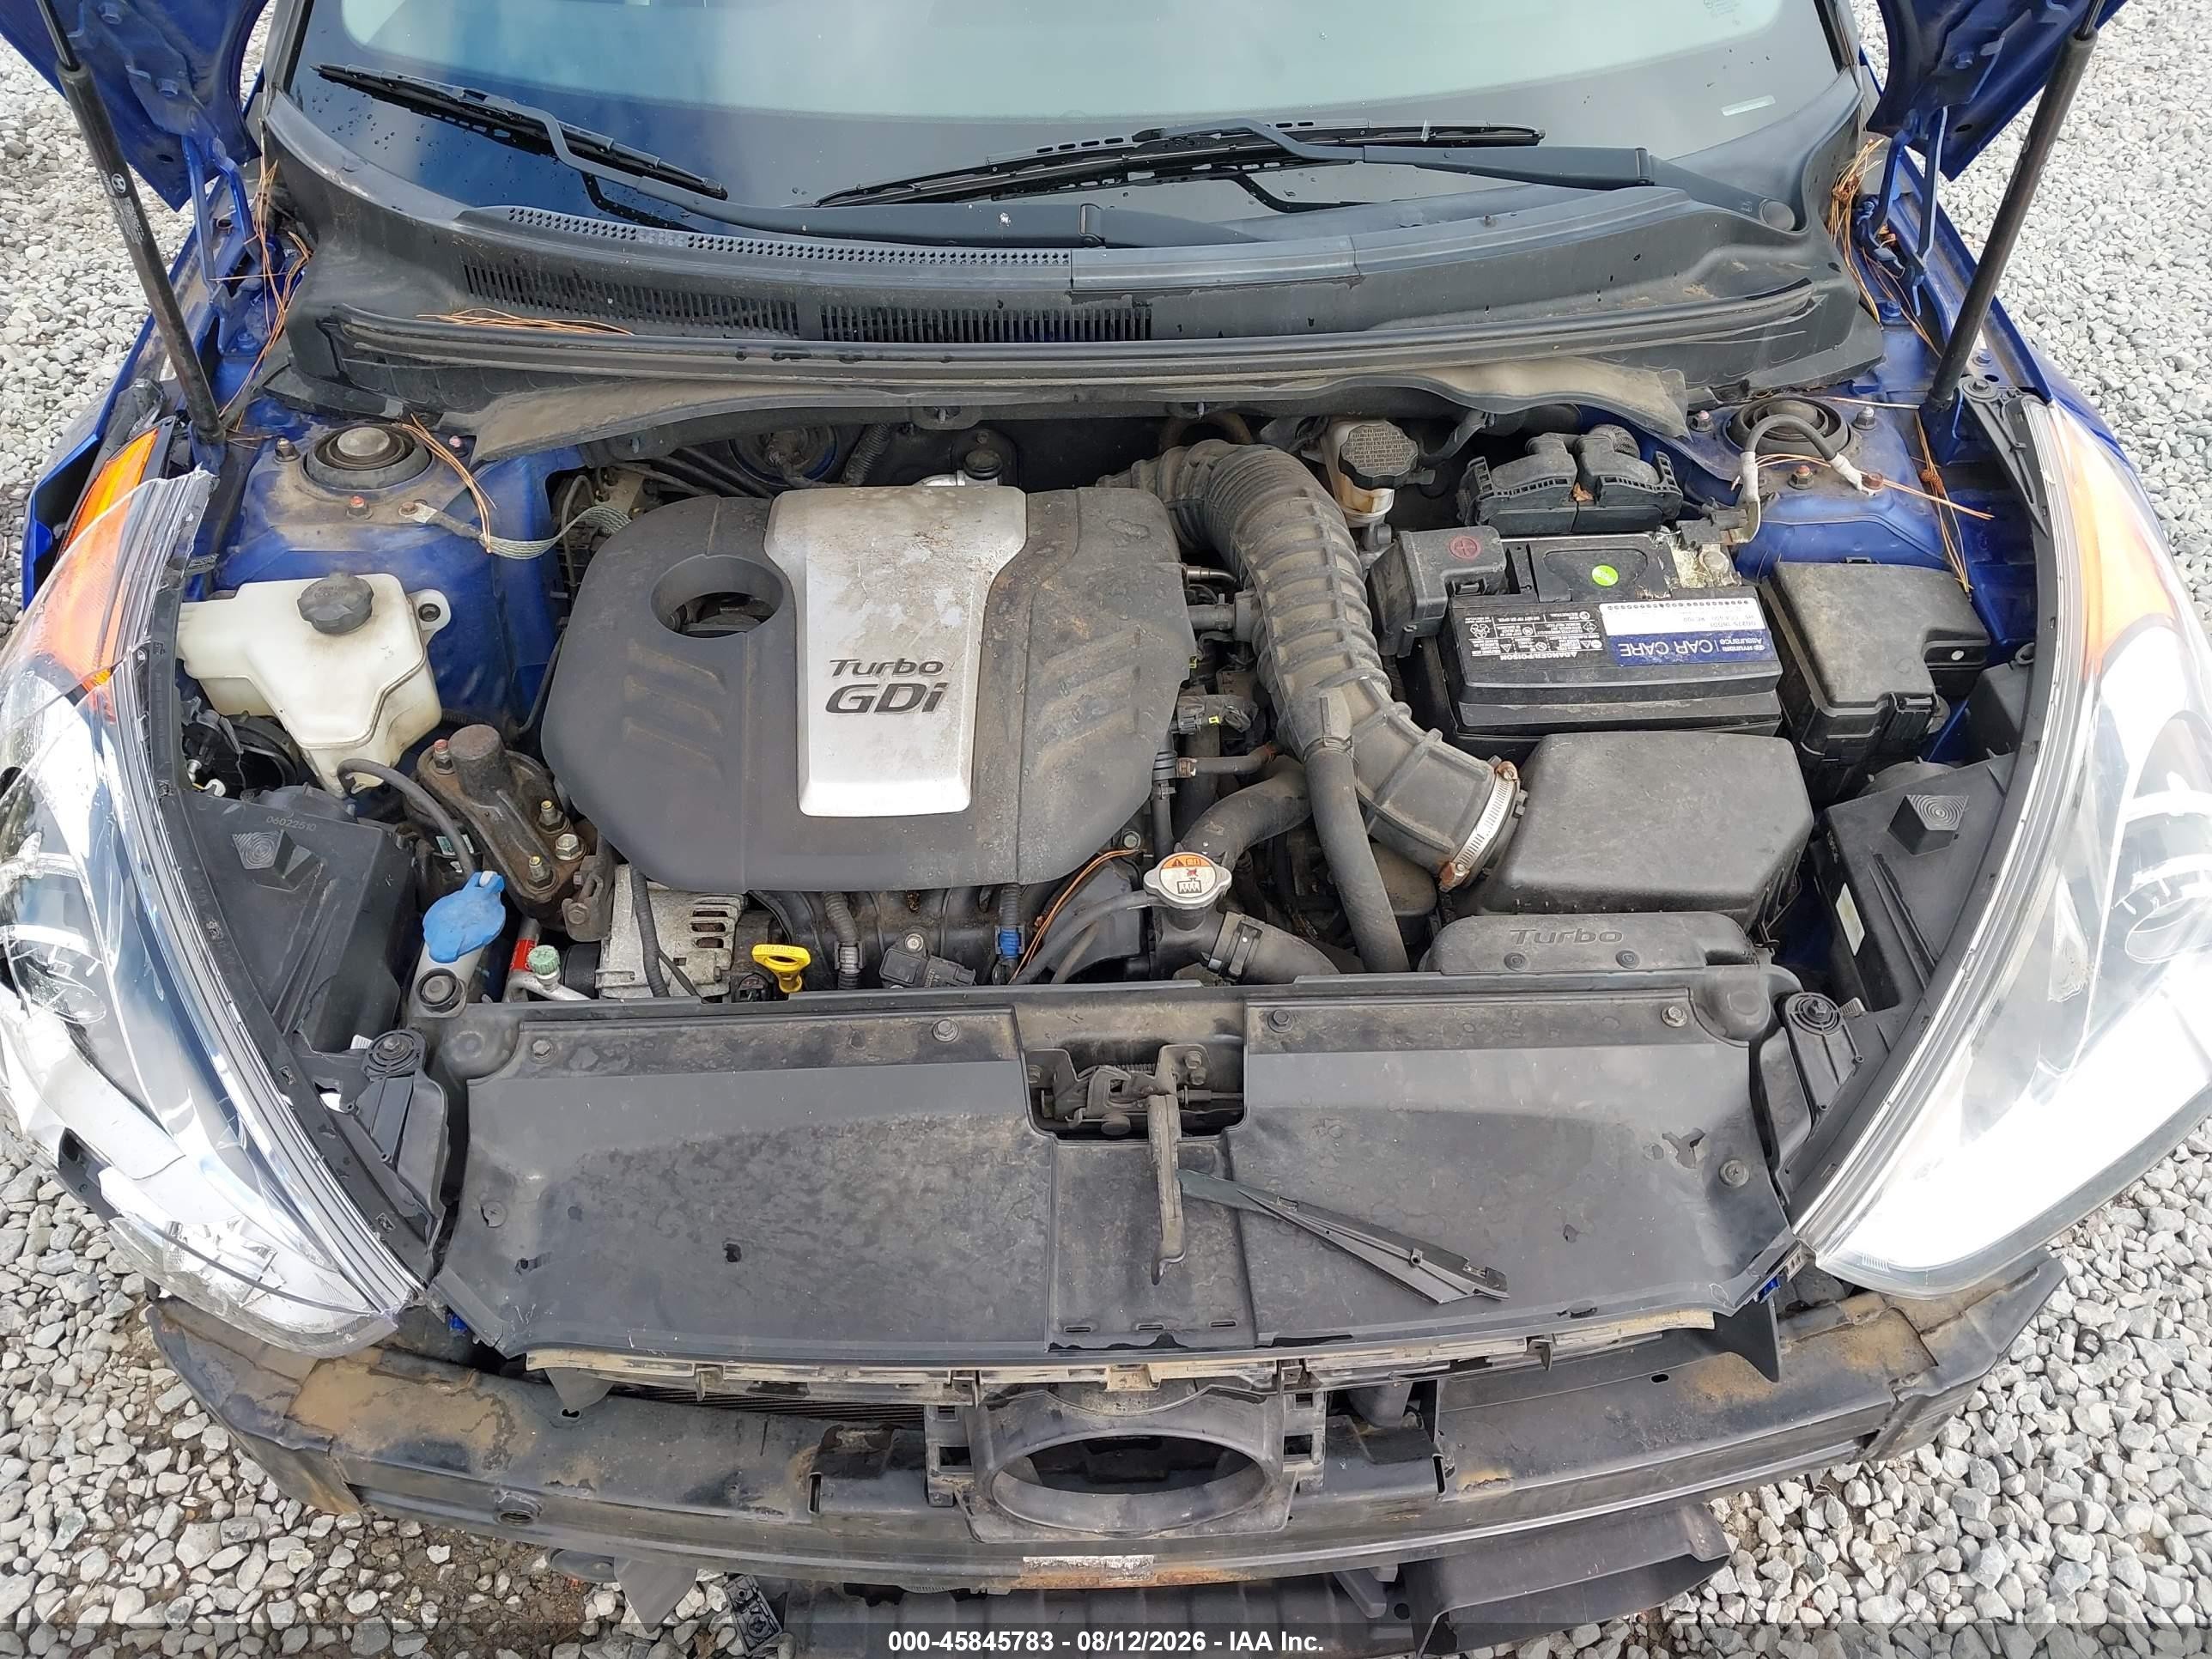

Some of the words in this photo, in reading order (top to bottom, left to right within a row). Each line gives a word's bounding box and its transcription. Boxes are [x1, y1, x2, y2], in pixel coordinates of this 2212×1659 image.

[1618, 640, 1669, 657] CARE
[1674, 639, 1714, 654] CAR
[1719, 637, 1763, 646] Assurance
[829, 658, 945, 677] Turbo
[825, 682, 949, 714] GDi
[1510, 927, 1623, 945] Turbo
